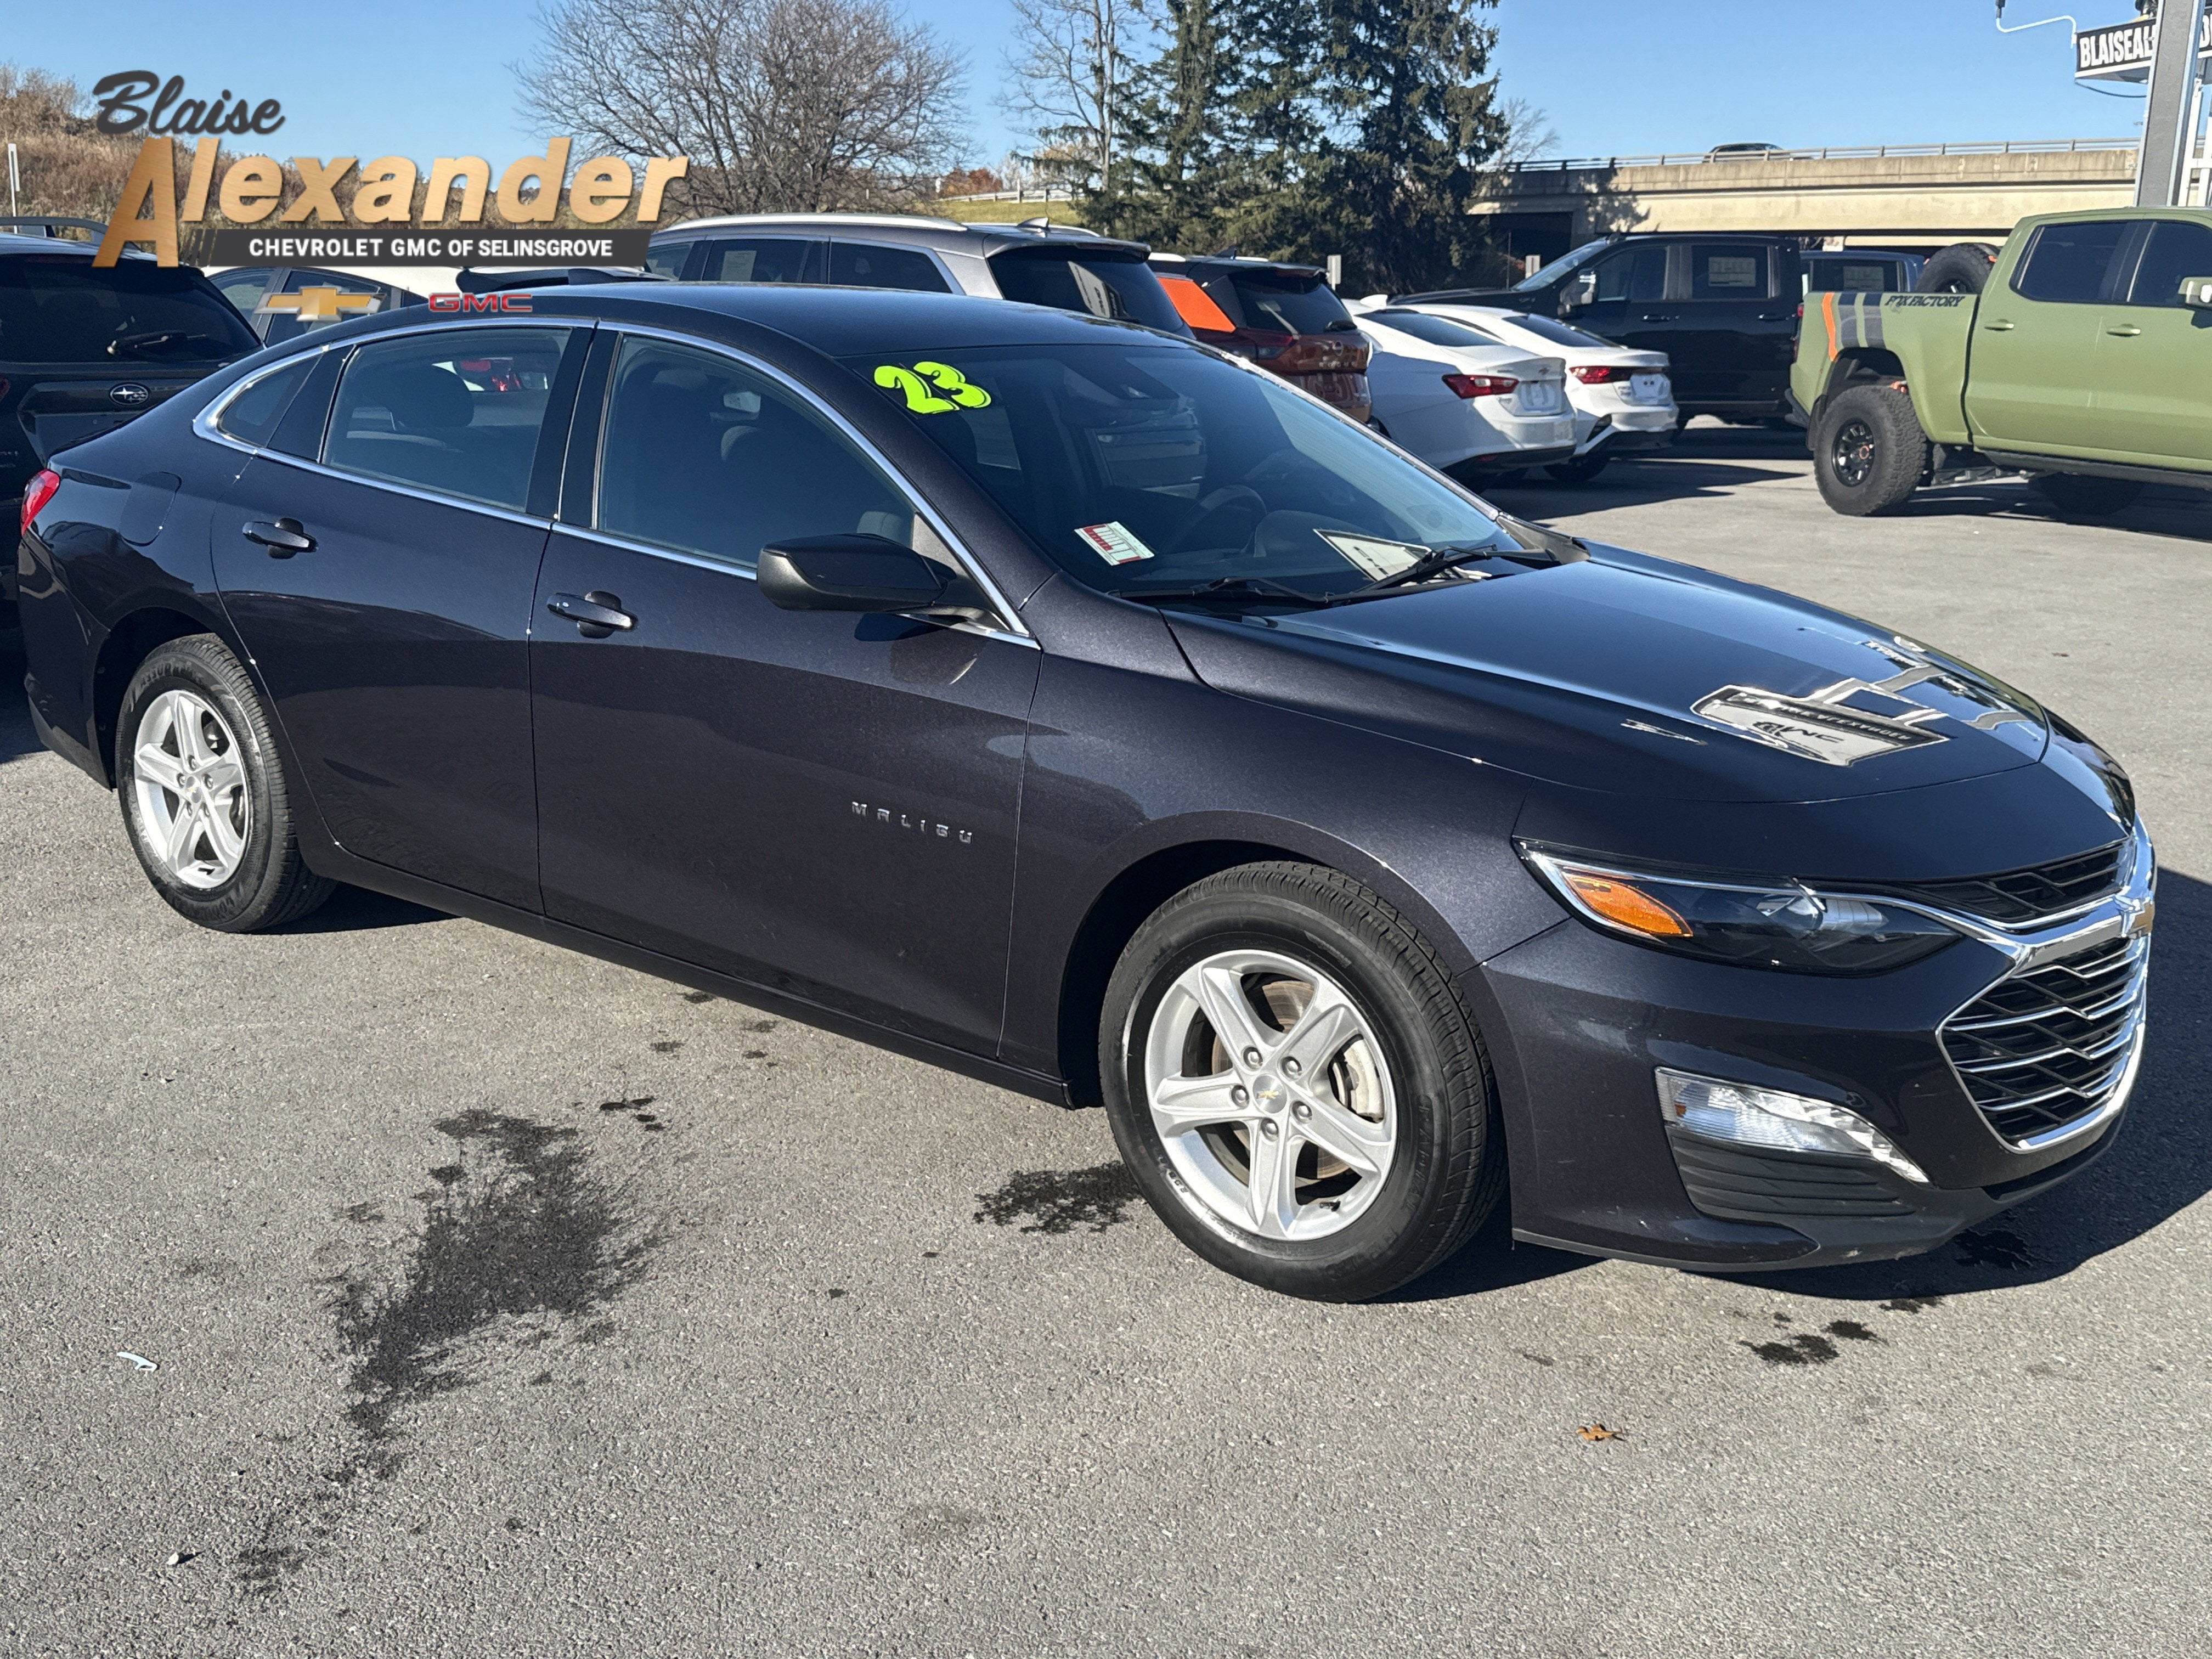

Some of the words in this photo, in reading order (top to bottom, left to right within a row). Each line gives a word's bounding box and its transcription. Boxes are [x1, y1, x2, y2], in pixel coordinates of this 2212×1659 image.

[2079, 25, 2157, 68] BLAISEAL
[872, 360, 993, 415] 23
[851, 801, 973, 844] MALIBU
